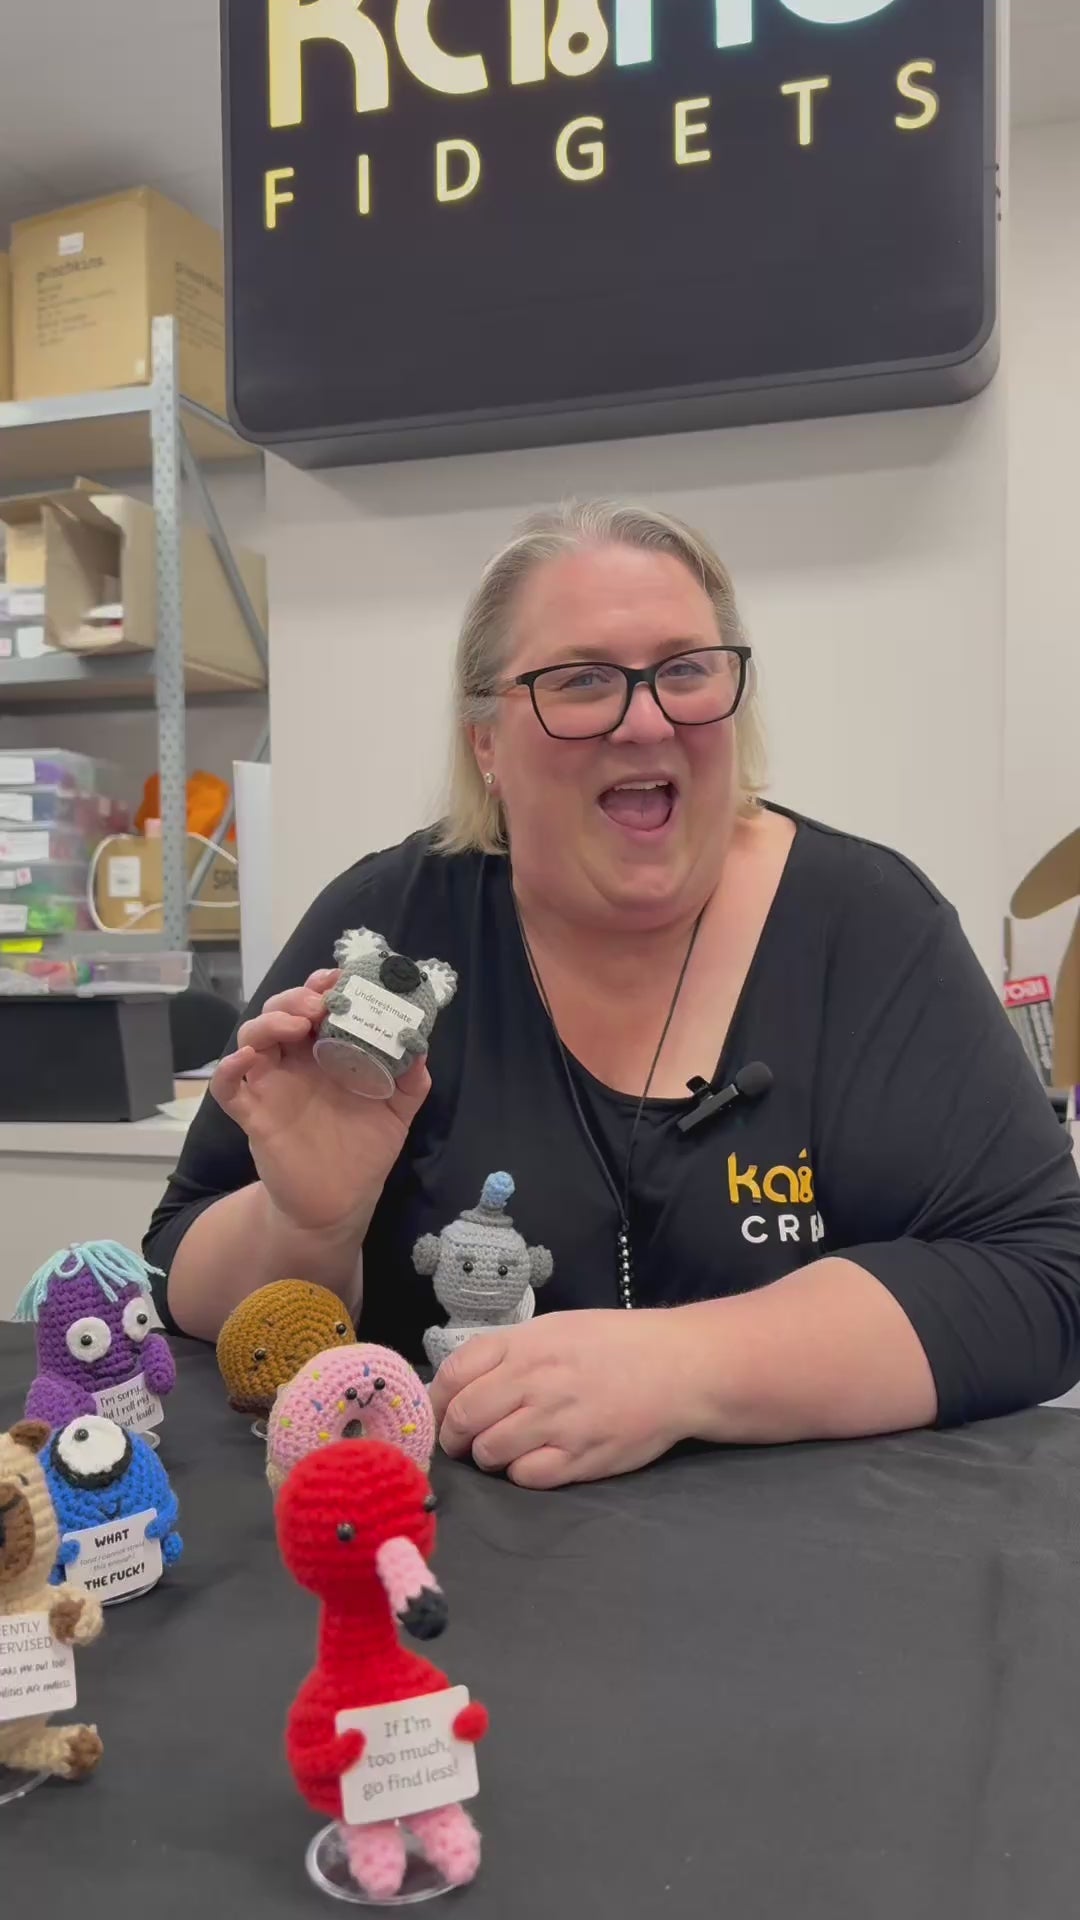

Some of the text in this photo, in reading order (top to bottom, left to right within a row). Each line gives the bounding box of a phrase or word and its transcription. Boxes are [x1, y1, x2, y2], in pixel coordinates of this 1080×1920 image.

[264, 60, 940, 230] FIDGETS
[354, 986, 412, 1023] Underestimate
[100, 1395, 115, 1408] I'm
[94, 1528, 130, 1548] WHAT
[84, 1562, 145, 1591] THE FUCK!
[0, 1620, 41, 1637] ENTLY
[384, 1715, 432, 1738] If I'm
[367, 1751, 396, 1769] too
[362, 1757, 460, 1802] go find less!
